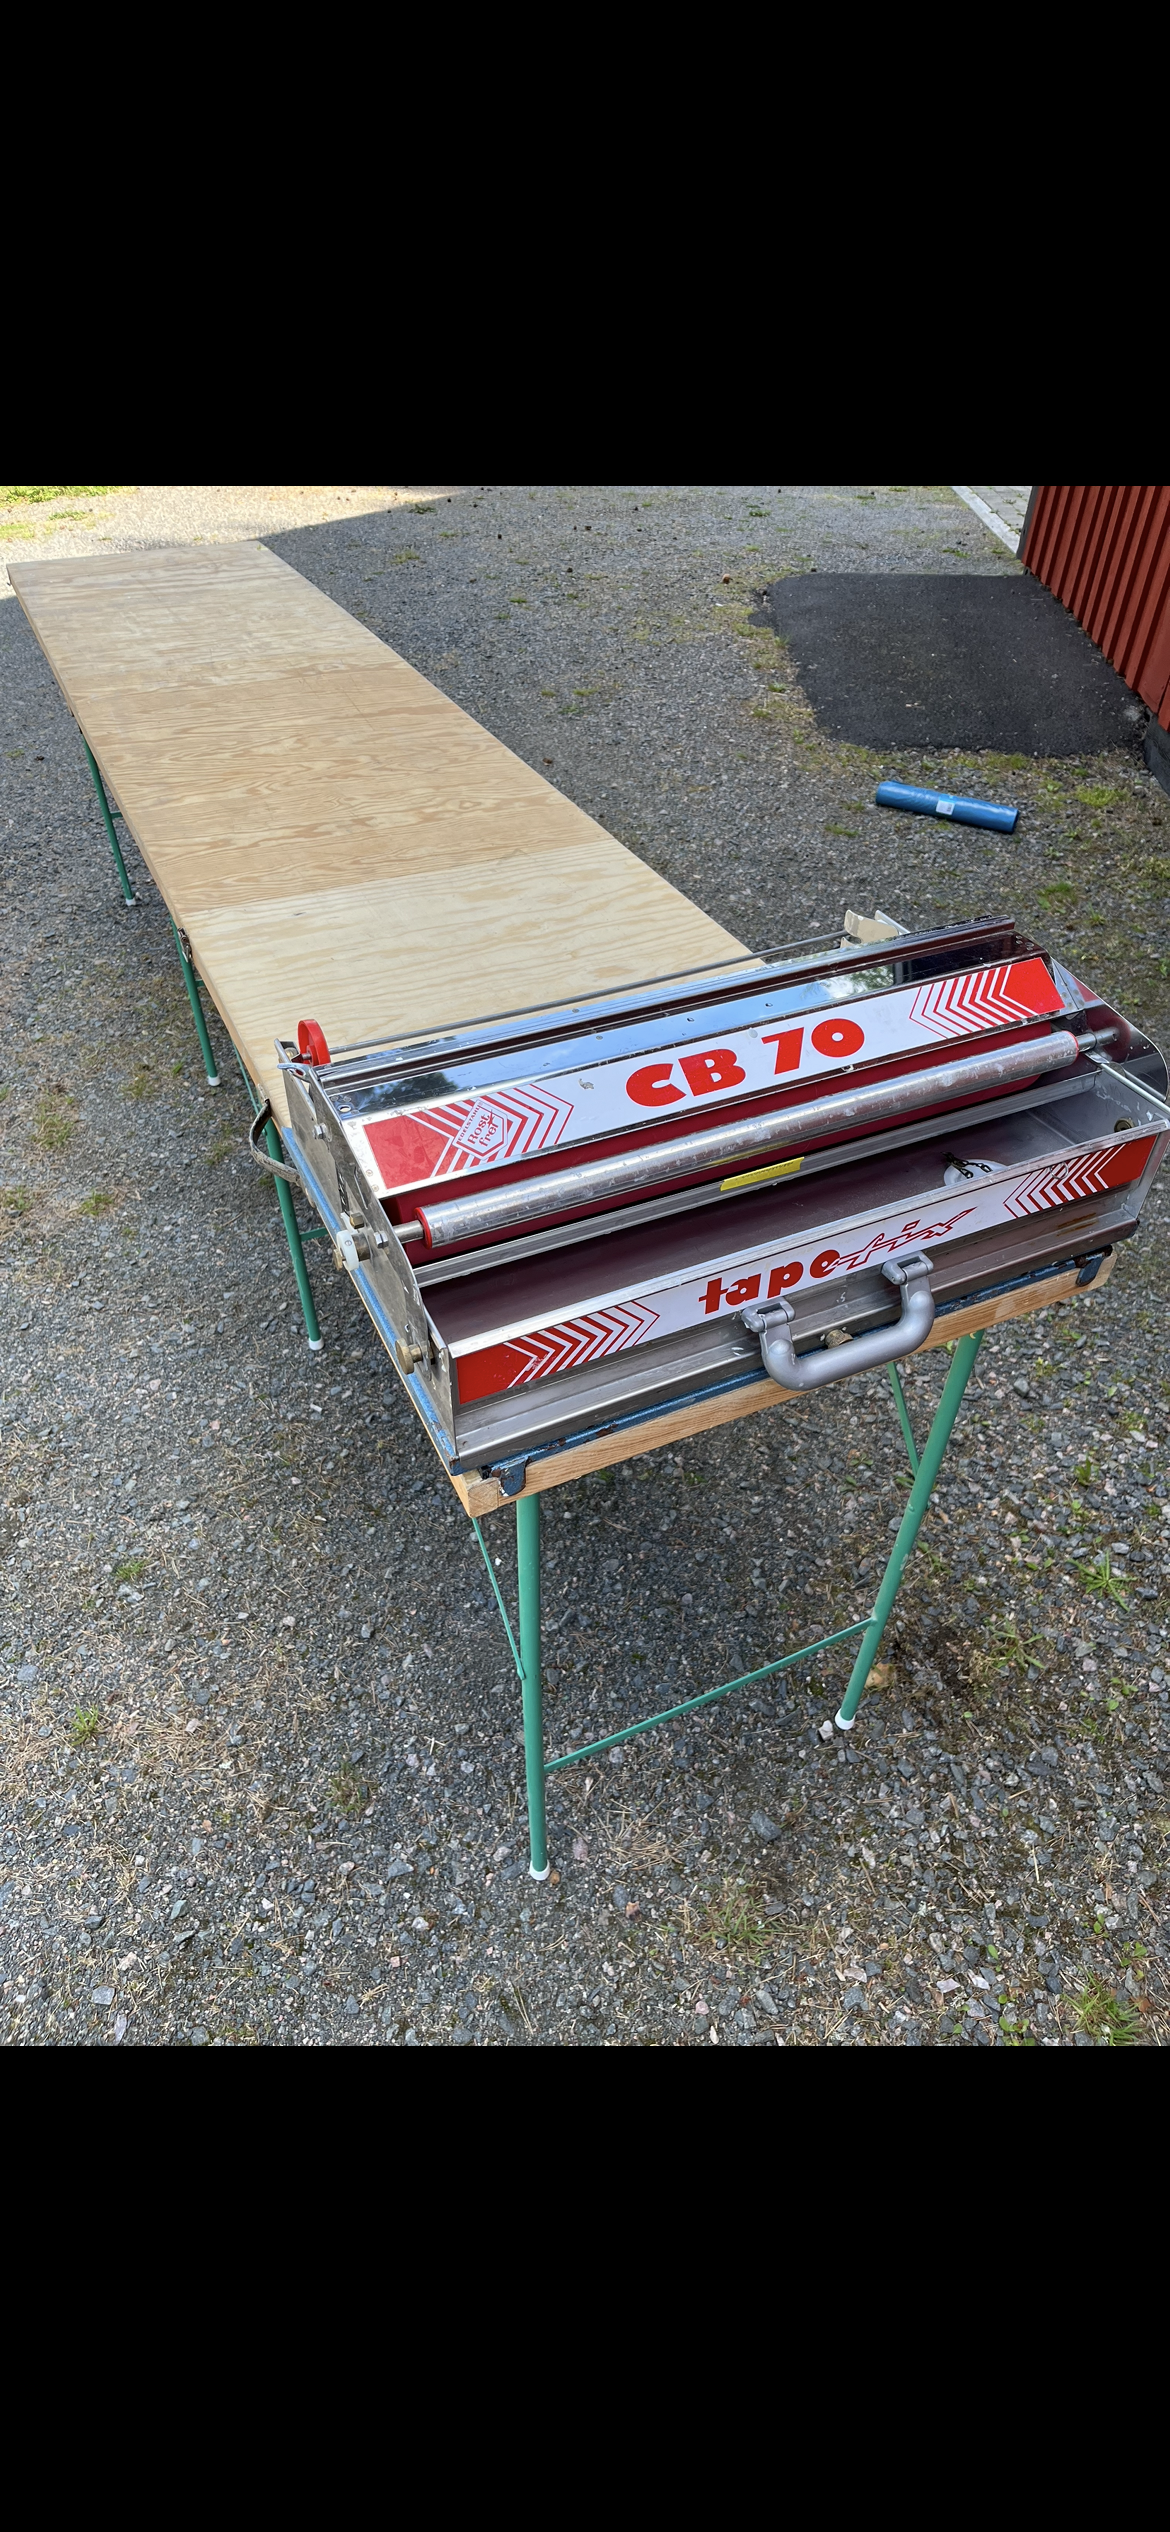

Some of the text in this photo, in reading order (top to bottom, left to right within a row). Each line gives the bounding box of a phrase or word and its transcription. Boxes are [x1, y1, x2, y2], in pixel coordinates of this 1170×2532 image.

[626, 1018, 865, 1107] CB 70
[467, 1113, 490, 1144] Rost
